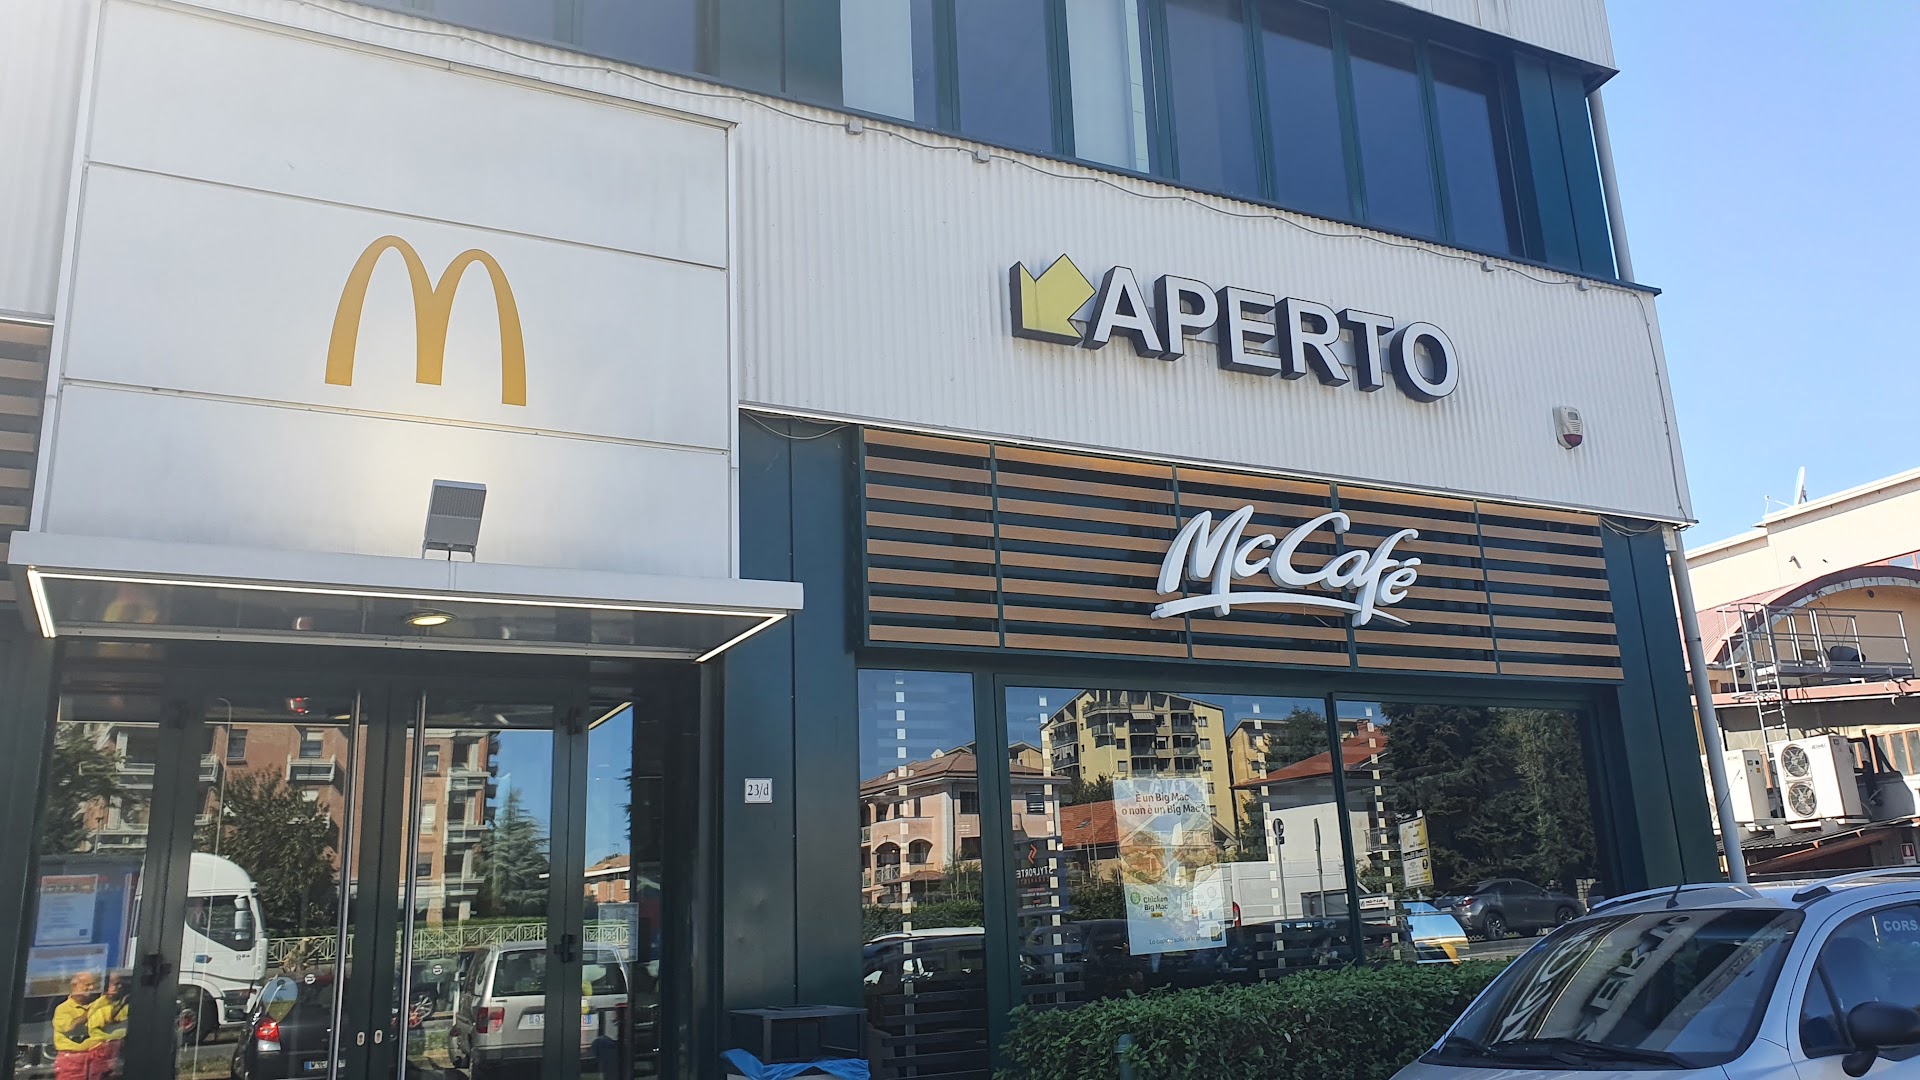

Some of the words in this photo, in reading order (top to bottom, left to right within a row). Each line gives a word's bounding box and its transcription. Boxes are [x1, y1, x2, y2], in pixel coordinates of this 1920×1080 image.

[1084, 265, 1460, 403] APERTO
[1152, 505, 1421, 627] McCafé
[747, 783, 769, 798] 23/d
[1135, 791, 1141, 802] È
[1155, 793, 1170, 804] Big
[1171, 792, 1189, 802] Mac
[1129, 807, 1146, 815] non
[1147, 805, 1153, 814] è
[1154, 806, 1166, 814] un
[1167, 804, 1182, 816] Big
[1183, 803, 1206, 813] Mac?
[1143, 896, 1168, 904] Chicken
[1144, 903, 1155, 912] Big
[1882, 919, 1920, 932] CORS
